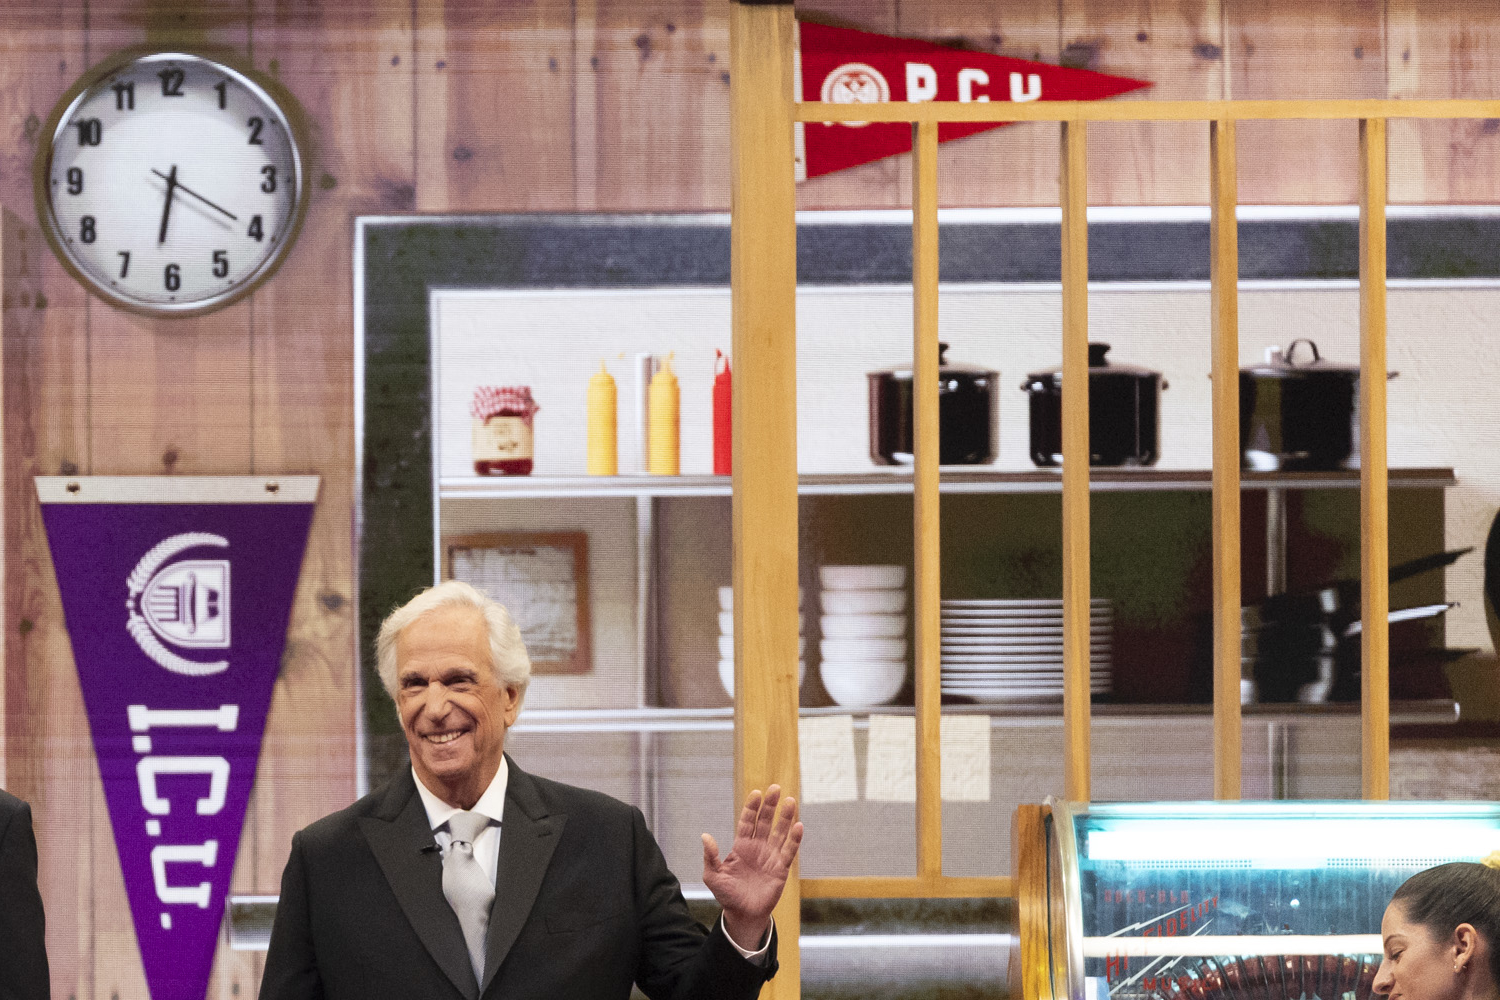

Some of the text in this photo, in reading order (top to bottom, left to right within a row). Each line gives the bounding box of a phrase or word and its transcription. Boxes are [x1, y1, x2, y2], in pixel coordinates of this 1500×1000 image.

[112, 81, 135, 110] 11
[158, 69, 185, 97] 12
[214, 81, 227, 110] 1
[76, 118, 101, 147] 10
[247, 116, 264, 145] 2
[66, 167, 83, 196] 9
[260, 165, 277, 194] 3
[80, 215, 96, 244] 8
[247, 215, 264, 242] 4
[117, 251, 131, 279] 7
[164, 263, 181, 292] 6
[212, 250, 229, 279] 5
[127, 705, 239, 930] I.C.U.
